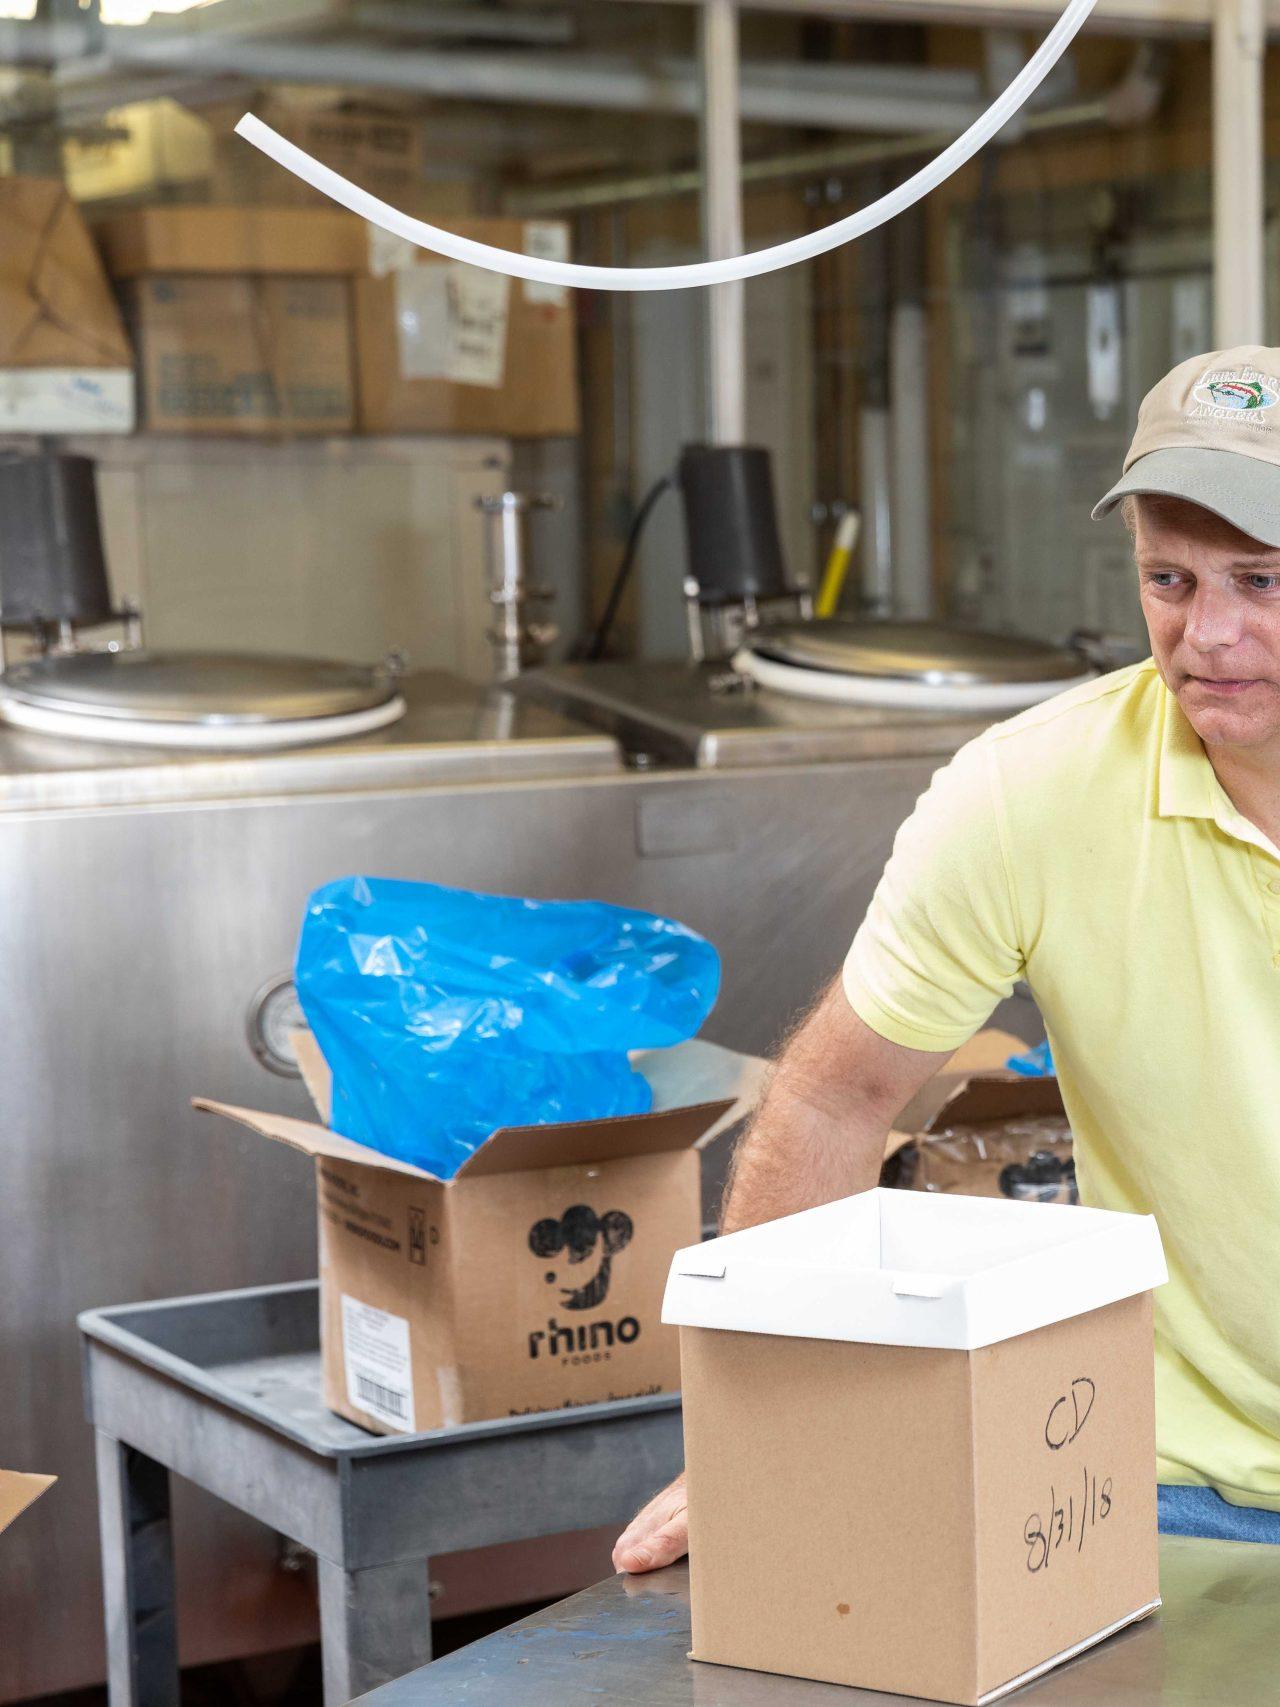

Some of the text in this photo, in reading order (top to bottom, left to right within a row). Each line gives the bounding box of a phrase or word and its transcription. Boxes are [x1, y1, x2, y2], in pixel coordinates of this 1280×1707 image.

[1188, 403, 1266, 424] ANGLERS
[528, 1316, 640, 1360] rhino
[562, 1352, 612, 1367] FOODS
[1045, 1377, 1096, 1450] CD
[1024, 1466, 1113, 1573] 8/31/18
